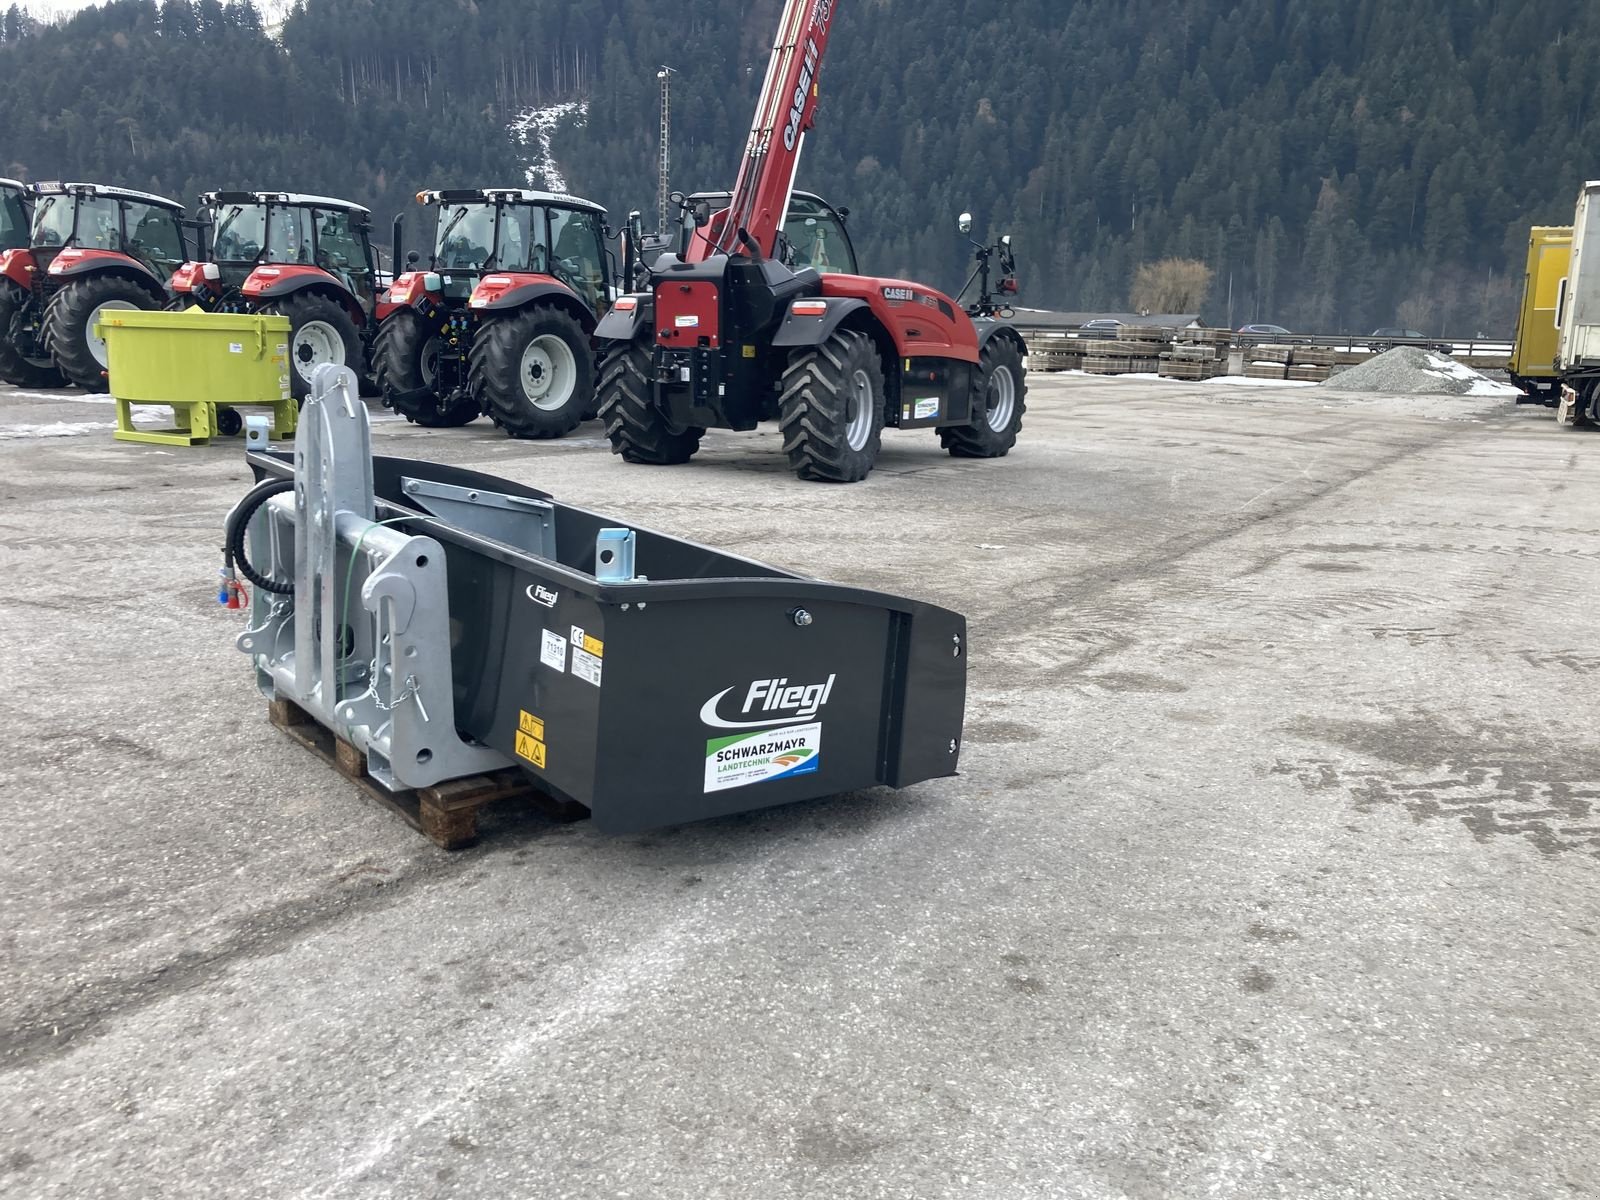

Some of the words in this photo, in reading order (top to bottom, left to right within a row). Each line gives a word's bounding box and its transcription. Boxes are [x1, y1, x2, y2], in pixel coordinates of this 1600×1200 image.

[534, 585, 559, 606] Fliegl
[546, 641, 564, 657] 71310
[741, 673, 837, 716] Fliegl
[716, 737, 806, 763] SCHWARZMAYR
[717, 757, 771, 773] LANDTECHNIK
